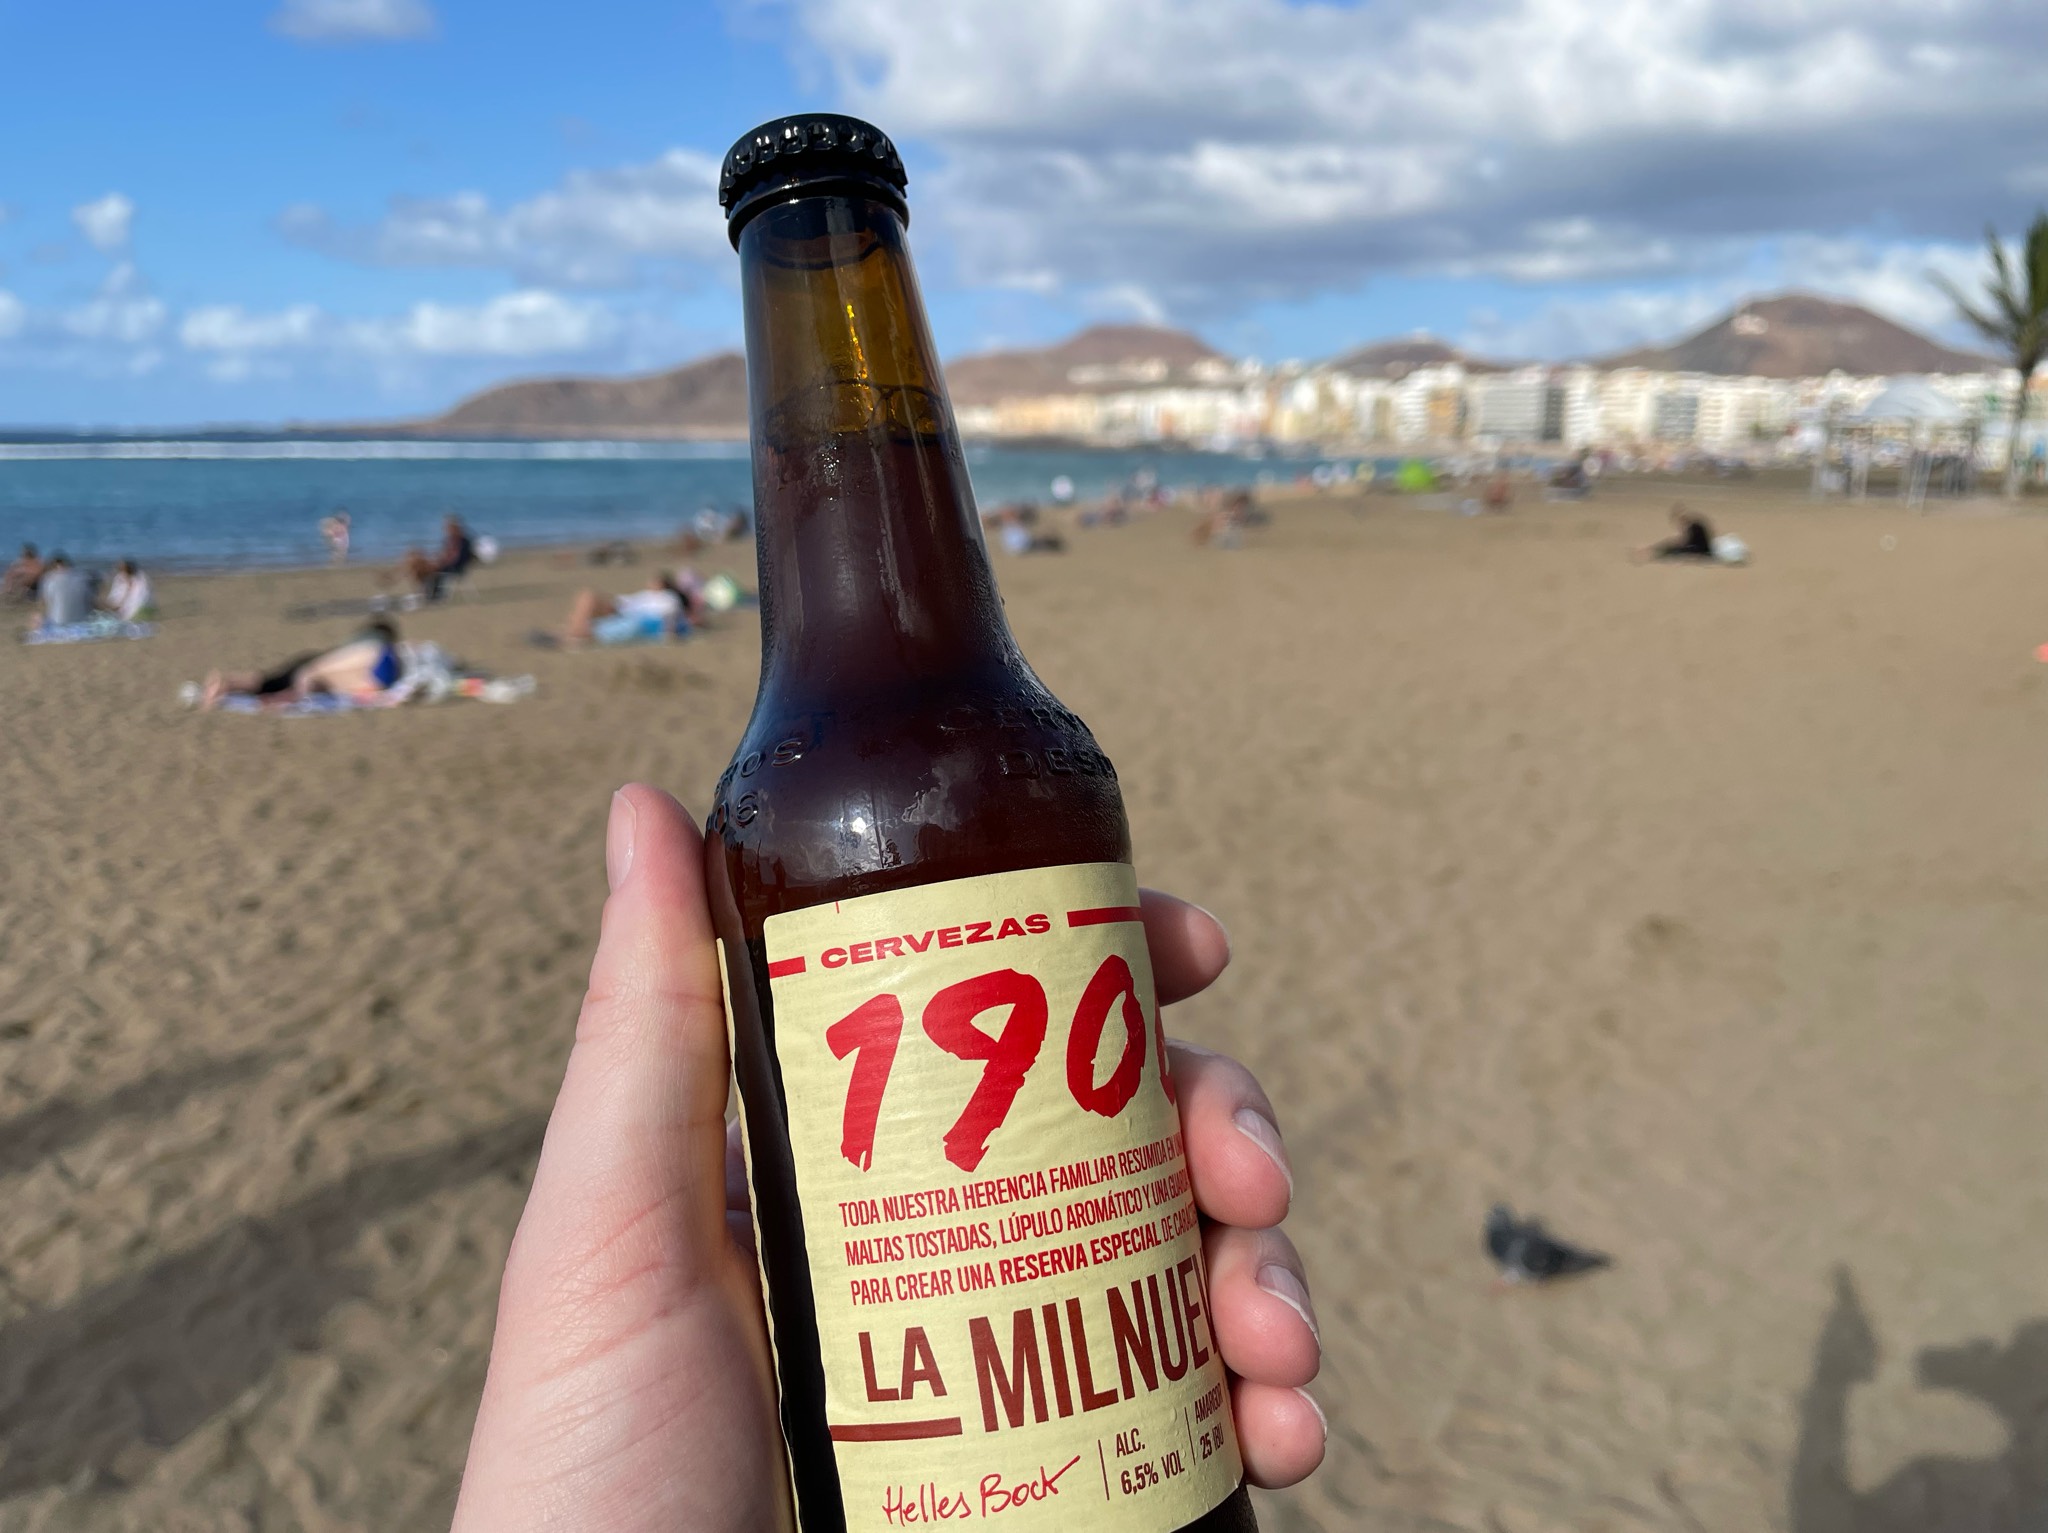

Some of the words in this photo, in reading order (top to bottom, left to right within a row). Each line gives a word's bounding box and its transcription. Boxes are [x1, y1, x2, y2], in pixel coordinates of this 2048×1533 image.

[820, 913, 1051, 969] CERVEZAS
[838, 1199, 881, 1228] TODA
[882, 1187, 961, 1223] NUESTRA
[963, 1170, 1047, 1210] HERENCIA
[1049, 1155, 1118, 1194] FAMILIAR
[1118, 1139, 1168, 1177] RESUMIDA
[1166, 1136, 1176, 1162] EN
[844, 1235, 905, 1267] MALTAS
[905, 1222, 998, 1259] TOSTADAS,
[998, 1207, 1064, 1246] LÚPULO
[1066, 1187, 1143, 1232] AROMÁTICO
[1142, 1183, 1152, 1209] Y
[1151, 1178, 1170, 1206] UNA
[850, 1277, 894, 1306] PARA
[895, 1270, 954, 1302] CREAR
[957, 1262, 997, 1292] UNA
[999, 1243, 1089, 1286] RESERVA
[1090, 1222, 1163, 1266] ESPECIAL
[1161, 1214, 1175, 1243] DE
[858, 1326, 948, 1403] LA
[1116, 1427, 1146, 1458] ALC.
[1120, 1464, 1159, 1497] 6,5%
[1161, 1449, 1186, 1480] VOL
[1199, 1431, 1213, 1461] 25
[881, 1482, 972, 1527] Helles
[980, 1455, 1081, 1519] Bock
